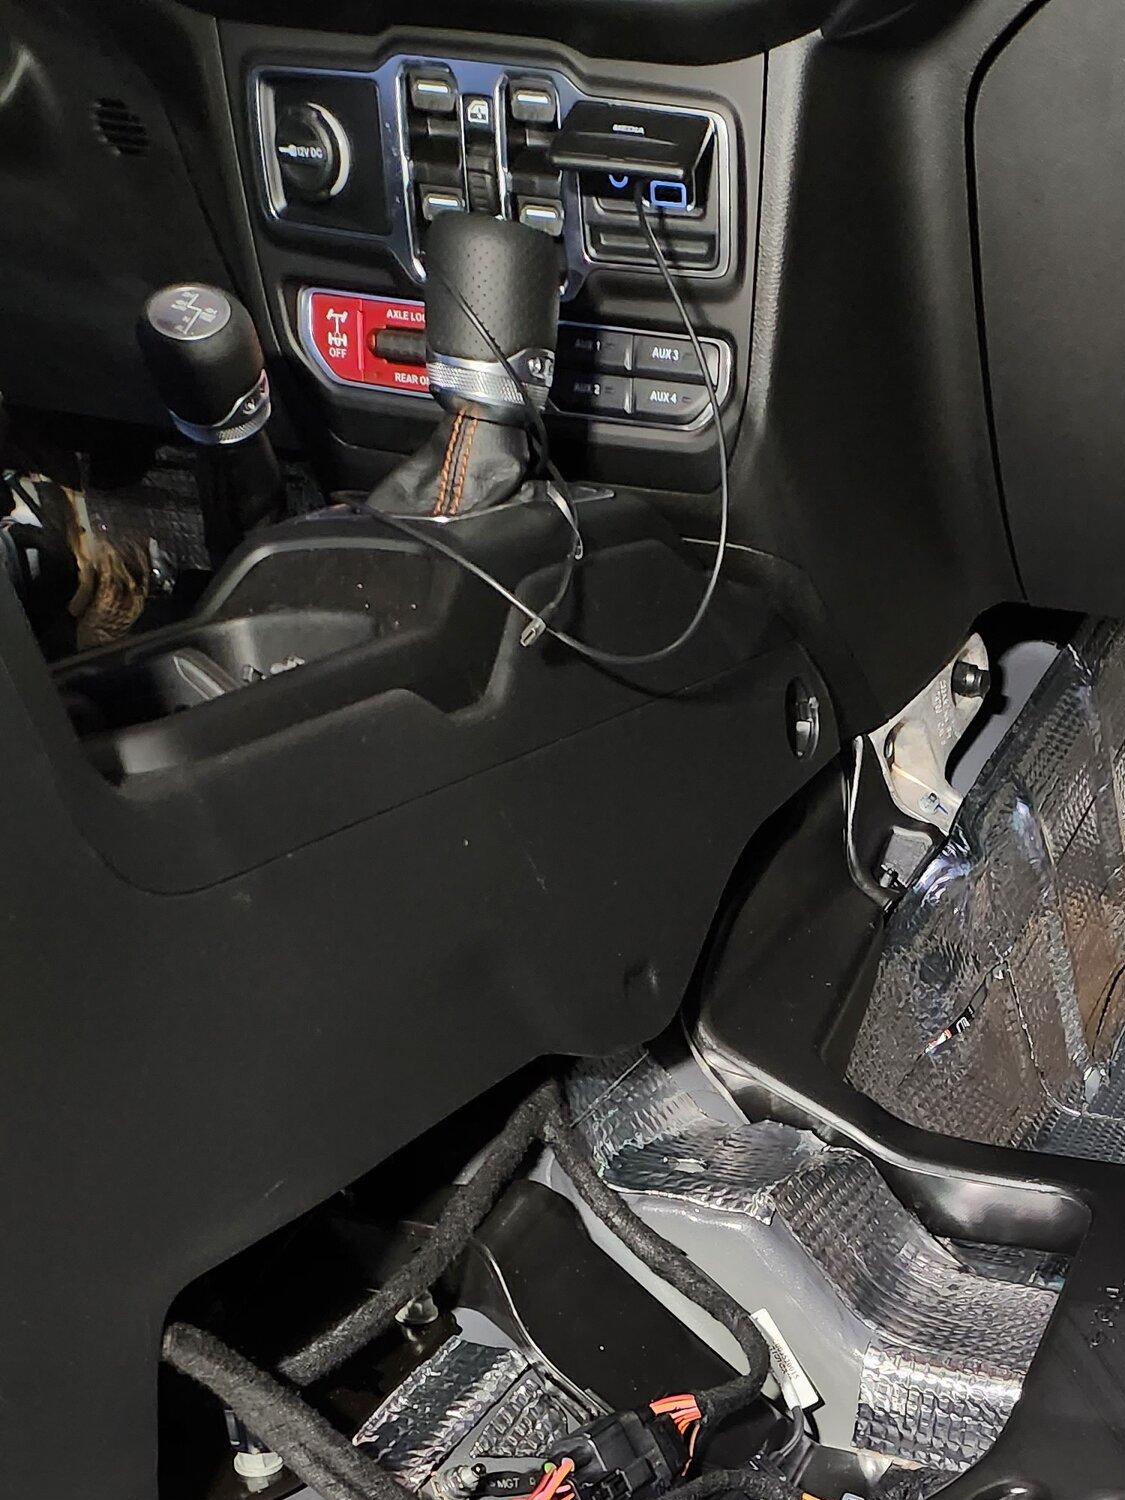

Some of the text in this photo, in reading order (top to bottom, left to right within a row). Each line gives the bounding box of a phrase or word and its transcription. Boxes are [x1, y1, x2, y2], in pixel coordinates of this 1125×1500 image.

[310, 146, 323, 159] DC
[386, 308, 409, 321] AXLE
[328, 347, 347, 359] OFF
[652, 346, 680, 361] AUX 3
[394, 372, 418, 384] REAR
[649, 390, 678, 404] AUX 4
